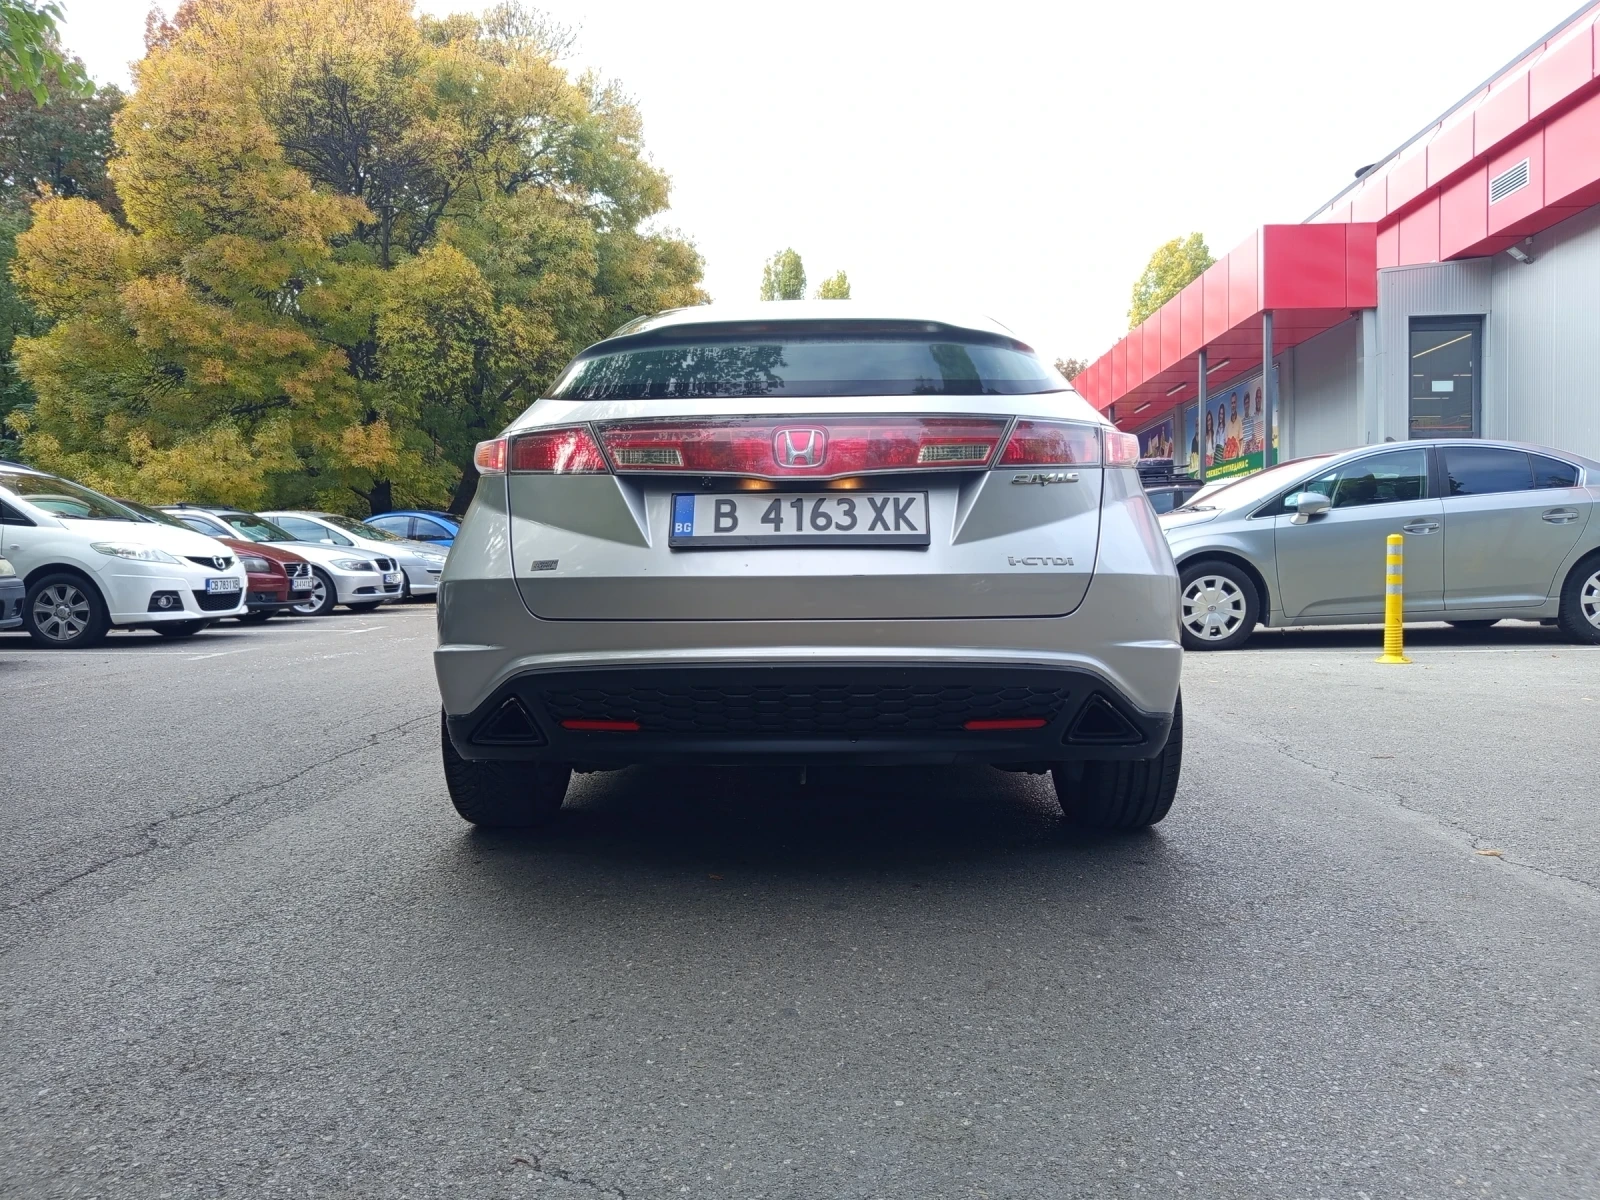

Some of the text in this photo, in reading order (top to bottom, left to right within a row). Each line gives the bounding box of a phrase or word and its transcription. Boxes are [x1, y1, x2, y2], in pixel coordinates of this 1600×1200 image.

[1011, 473, 1079, 487] CIVIC
[713, 497, 918, 533] B 4163 XK
[675, 522, 692, 533] BG
